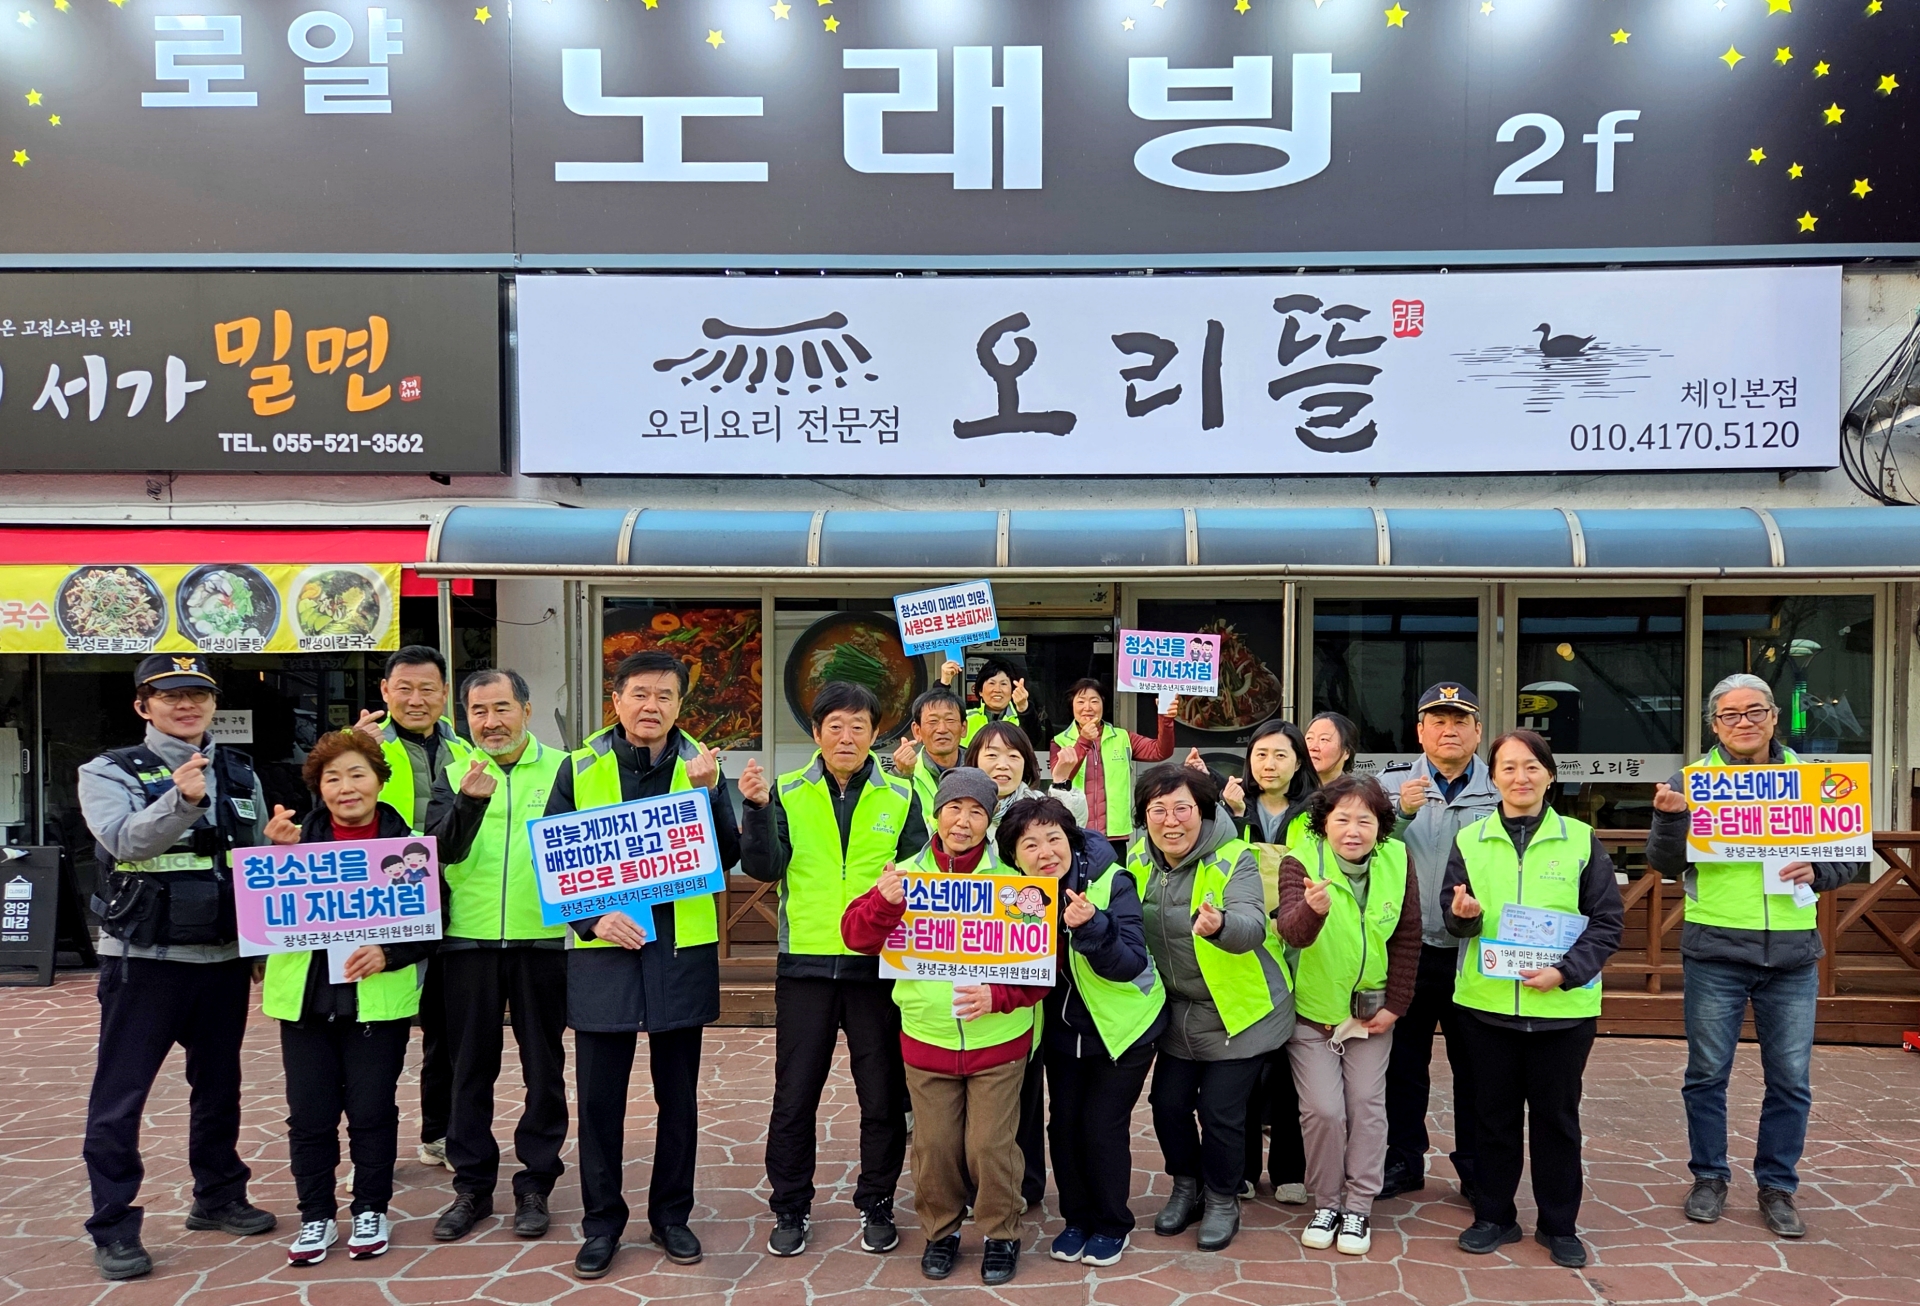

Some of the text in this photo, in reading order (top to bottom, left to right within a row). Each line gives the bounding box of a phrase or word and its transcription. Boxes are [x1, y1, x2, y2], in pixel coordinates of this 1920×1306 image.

[141, 8, 1641, 195] 로얄 노래방 2f
[21, 318, 104, 337] 고집스러운
[109, 318, 131, 337] 맛!
[1394, 304, 1423, 332] 張
[33, 355, 206, 423] 서가
[215, 310, 390, 415] 밀면
[953, 295, 1387, 453] 오리뜰
[1681, 378, 1798, 410] 체인본점
[641, 405, 900, 444] 오리요리 전문점
[1570, 420, 1799, 453] 010.4170.5120
[219, 433, 424, 454] TEL. 055-521-3562
[0, 602, 50, 629] 국수
[900, 599, 937, 619] 청소년이
[938, 594, 966, 611] 미래의
[904, 607, 993, 636] 사랑으로 보살피자!!
[66, 638, 153, 651] 북성로불고기
[199, 637, 264, 651] 매생이굴탕
[299, 635, 376, 650] 매생이칼국수
[1125, 636, 1185, 657] 청소년을
[1133, 659, 1212, 681] 내 자녀처럼
[1589, 759, 1640, 777] 오리뜰
[1691, 771, 1799, 801] 청소년에게
[543, 800, 698, 849] 밤늦게까지 거리를
[1692, 805, 1862, 835] 술·담배 판매 NO!
[544, 823, 705, 873] 배회하지 말고 일찍
[1725, 846, 1867, 858] 창녕군청소년지도위원협의회
[244, 850, 368, 889] 청소년을
[558, 849, 701, 896] 집으로 돌아가요!
[4, 902, 29, 915] 영업
[265, 884, 425, 926] 내 자녀처럼
[560, 877, 708, 917] 창녕군청소년지도위원협의회
[902, 879, 992, 914] 소년에게
[2, 917, 29, 929] 마감
[284, 923, 435, 947] 창녕군청소년지도위원협의회
[962, 920, 1003, 953] 판매
[1010, 923, 1048, 953] NO!
[1500, 950, 1516, 958] 19세
[1519, 951, 1533, 960] 미만
[916, 963, 1050, 981] 창녕군청소년지도위원협의회
